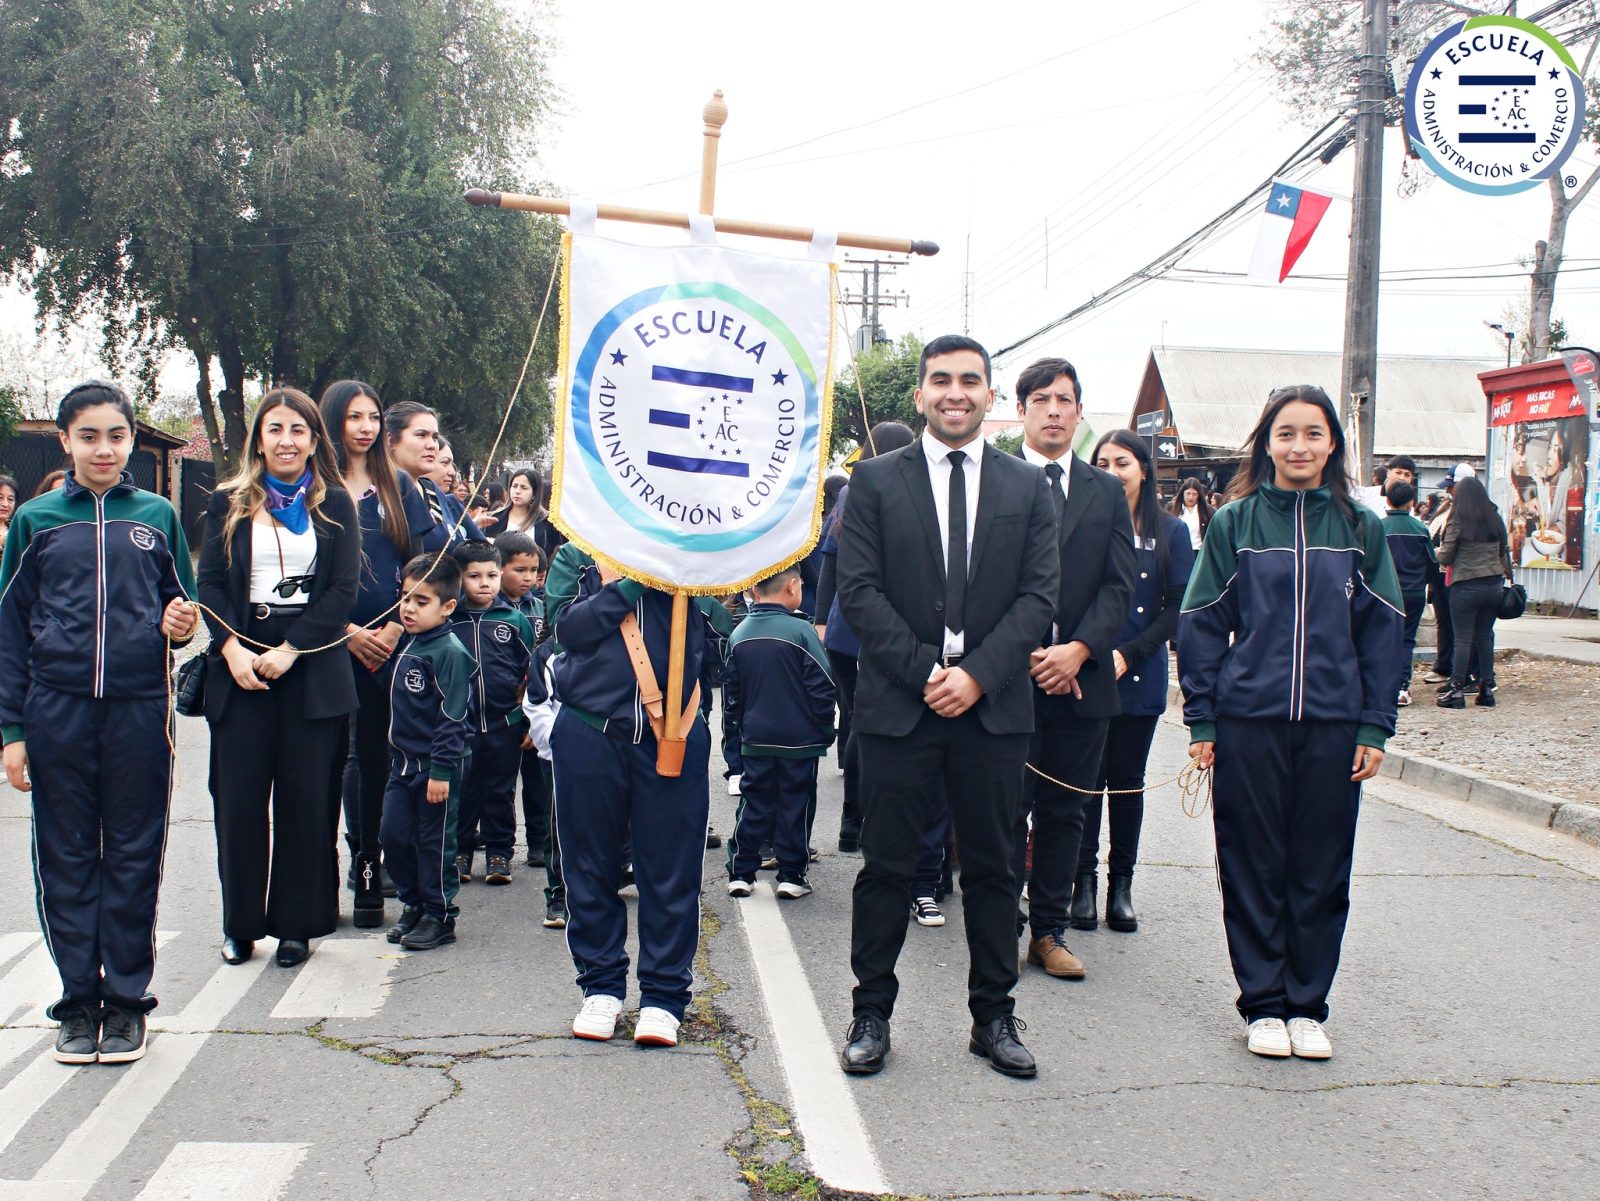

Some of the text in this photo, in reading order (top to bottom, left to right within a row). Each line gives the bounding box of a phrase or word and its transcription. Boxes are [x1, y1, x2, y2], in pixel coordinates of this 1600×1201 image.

[633, 310, 767, 364] ESCUELA
[1529, 404, 1539, 415] NO
[598, 376, 795, 525] ADMINISTRACIÓN & COMERCIO
[715, 423, 738, 442] AC
